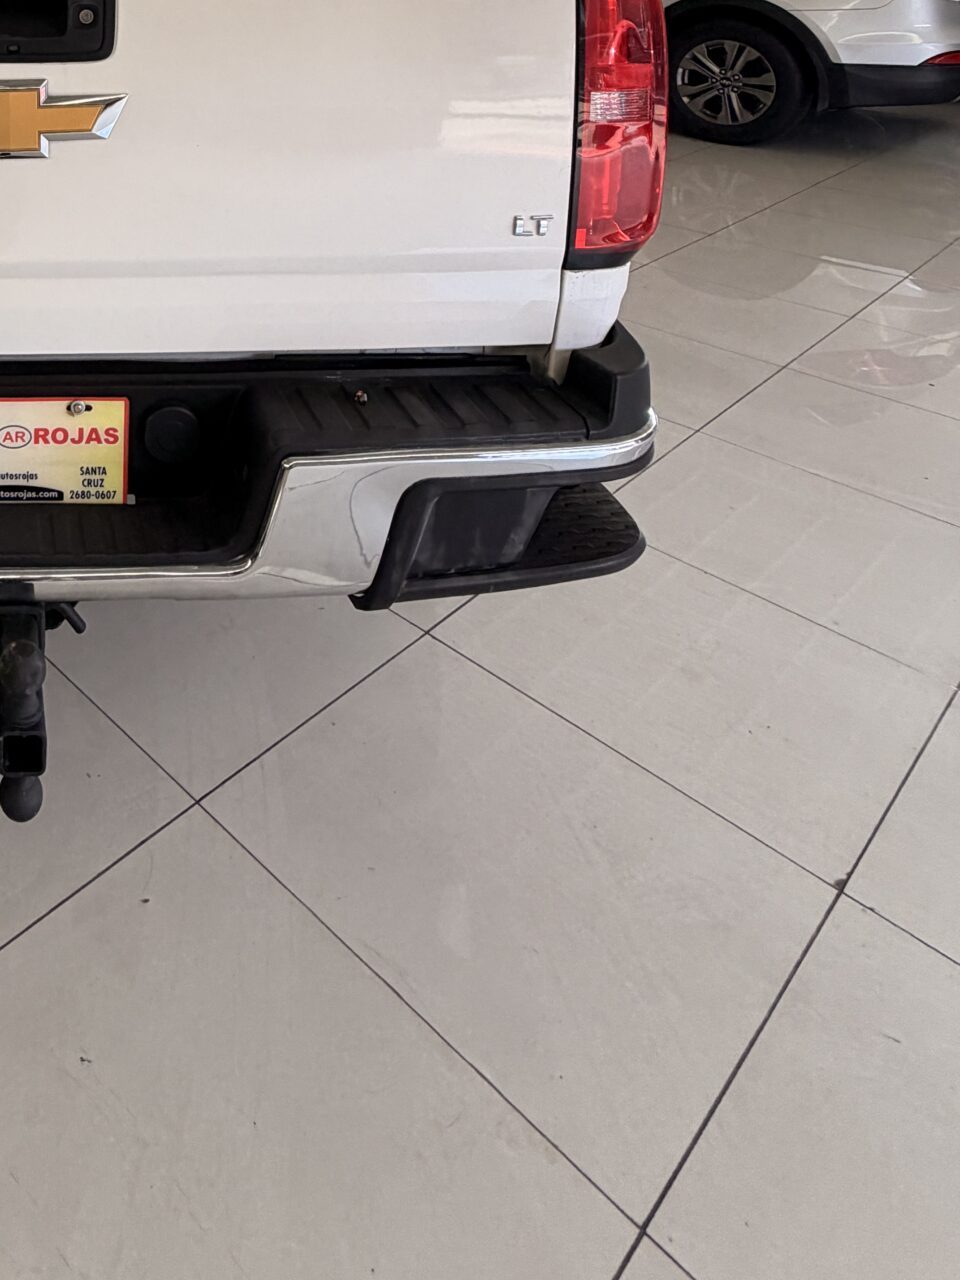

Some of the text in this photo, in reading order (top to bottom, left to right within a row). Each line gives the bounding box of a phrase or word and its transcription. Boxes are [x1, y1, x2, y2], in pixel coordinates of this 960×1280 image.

[512, 215, 554, 236] LT
[2, 431, 26, 443] AR
[33, 427, 119, 445] ROJAS
[80, 466, 107, 476] SANTA
[82, 478, 104, 488] CRUZ
[69, 490, 117, 500] 2680-0607
